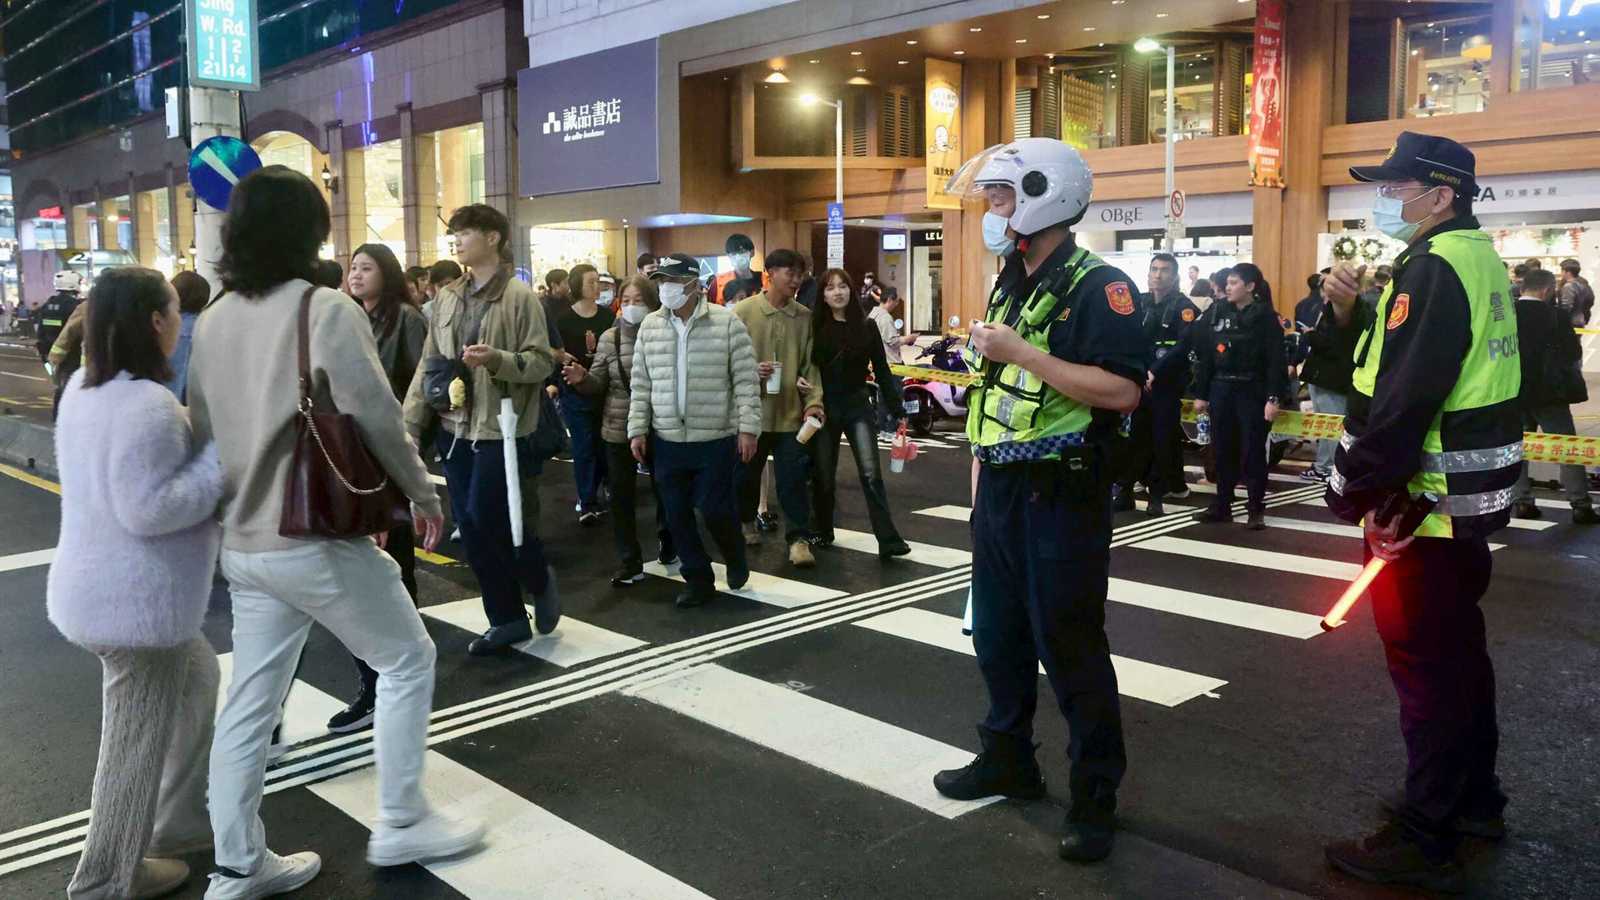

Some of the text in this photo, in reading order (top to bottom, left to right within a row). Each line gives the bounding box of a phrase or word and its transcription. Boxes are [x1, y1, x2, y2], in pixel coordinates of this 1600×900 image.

[200, 15, 247, 36] W. Rd.
[202, 60, 247, 79] 21 14
[563, 98, 621, 131] 誠品書店
[1101, 207, 1144, 225] OBgE
[926, 232, 935, 240] LE
